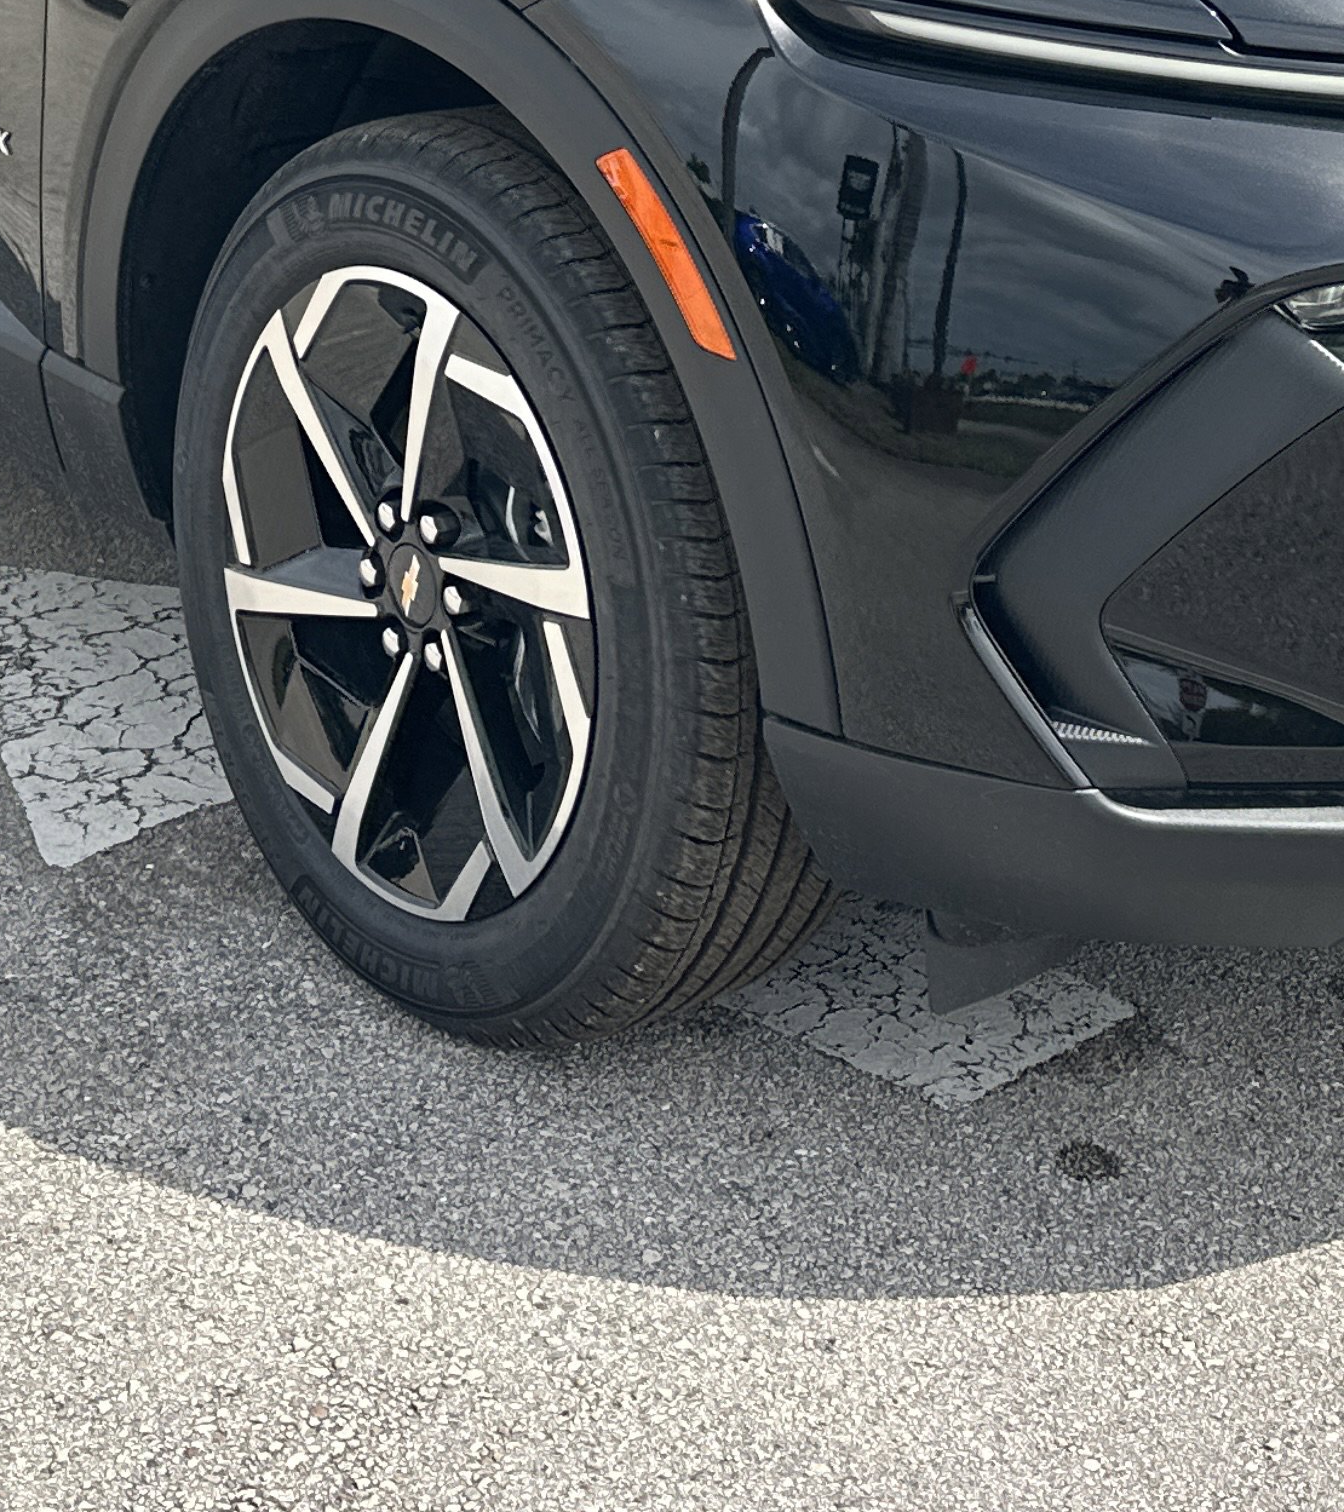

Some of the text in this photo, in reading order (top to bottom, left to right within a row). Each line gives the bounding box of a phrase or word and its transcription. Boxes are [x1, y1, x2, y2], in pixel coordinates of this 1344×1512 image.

[328, 191, 478, 272] MICHELIN
[498, 288, 576, 402] PRIMACY
[297, 886, 439, 997] MICHELIN
